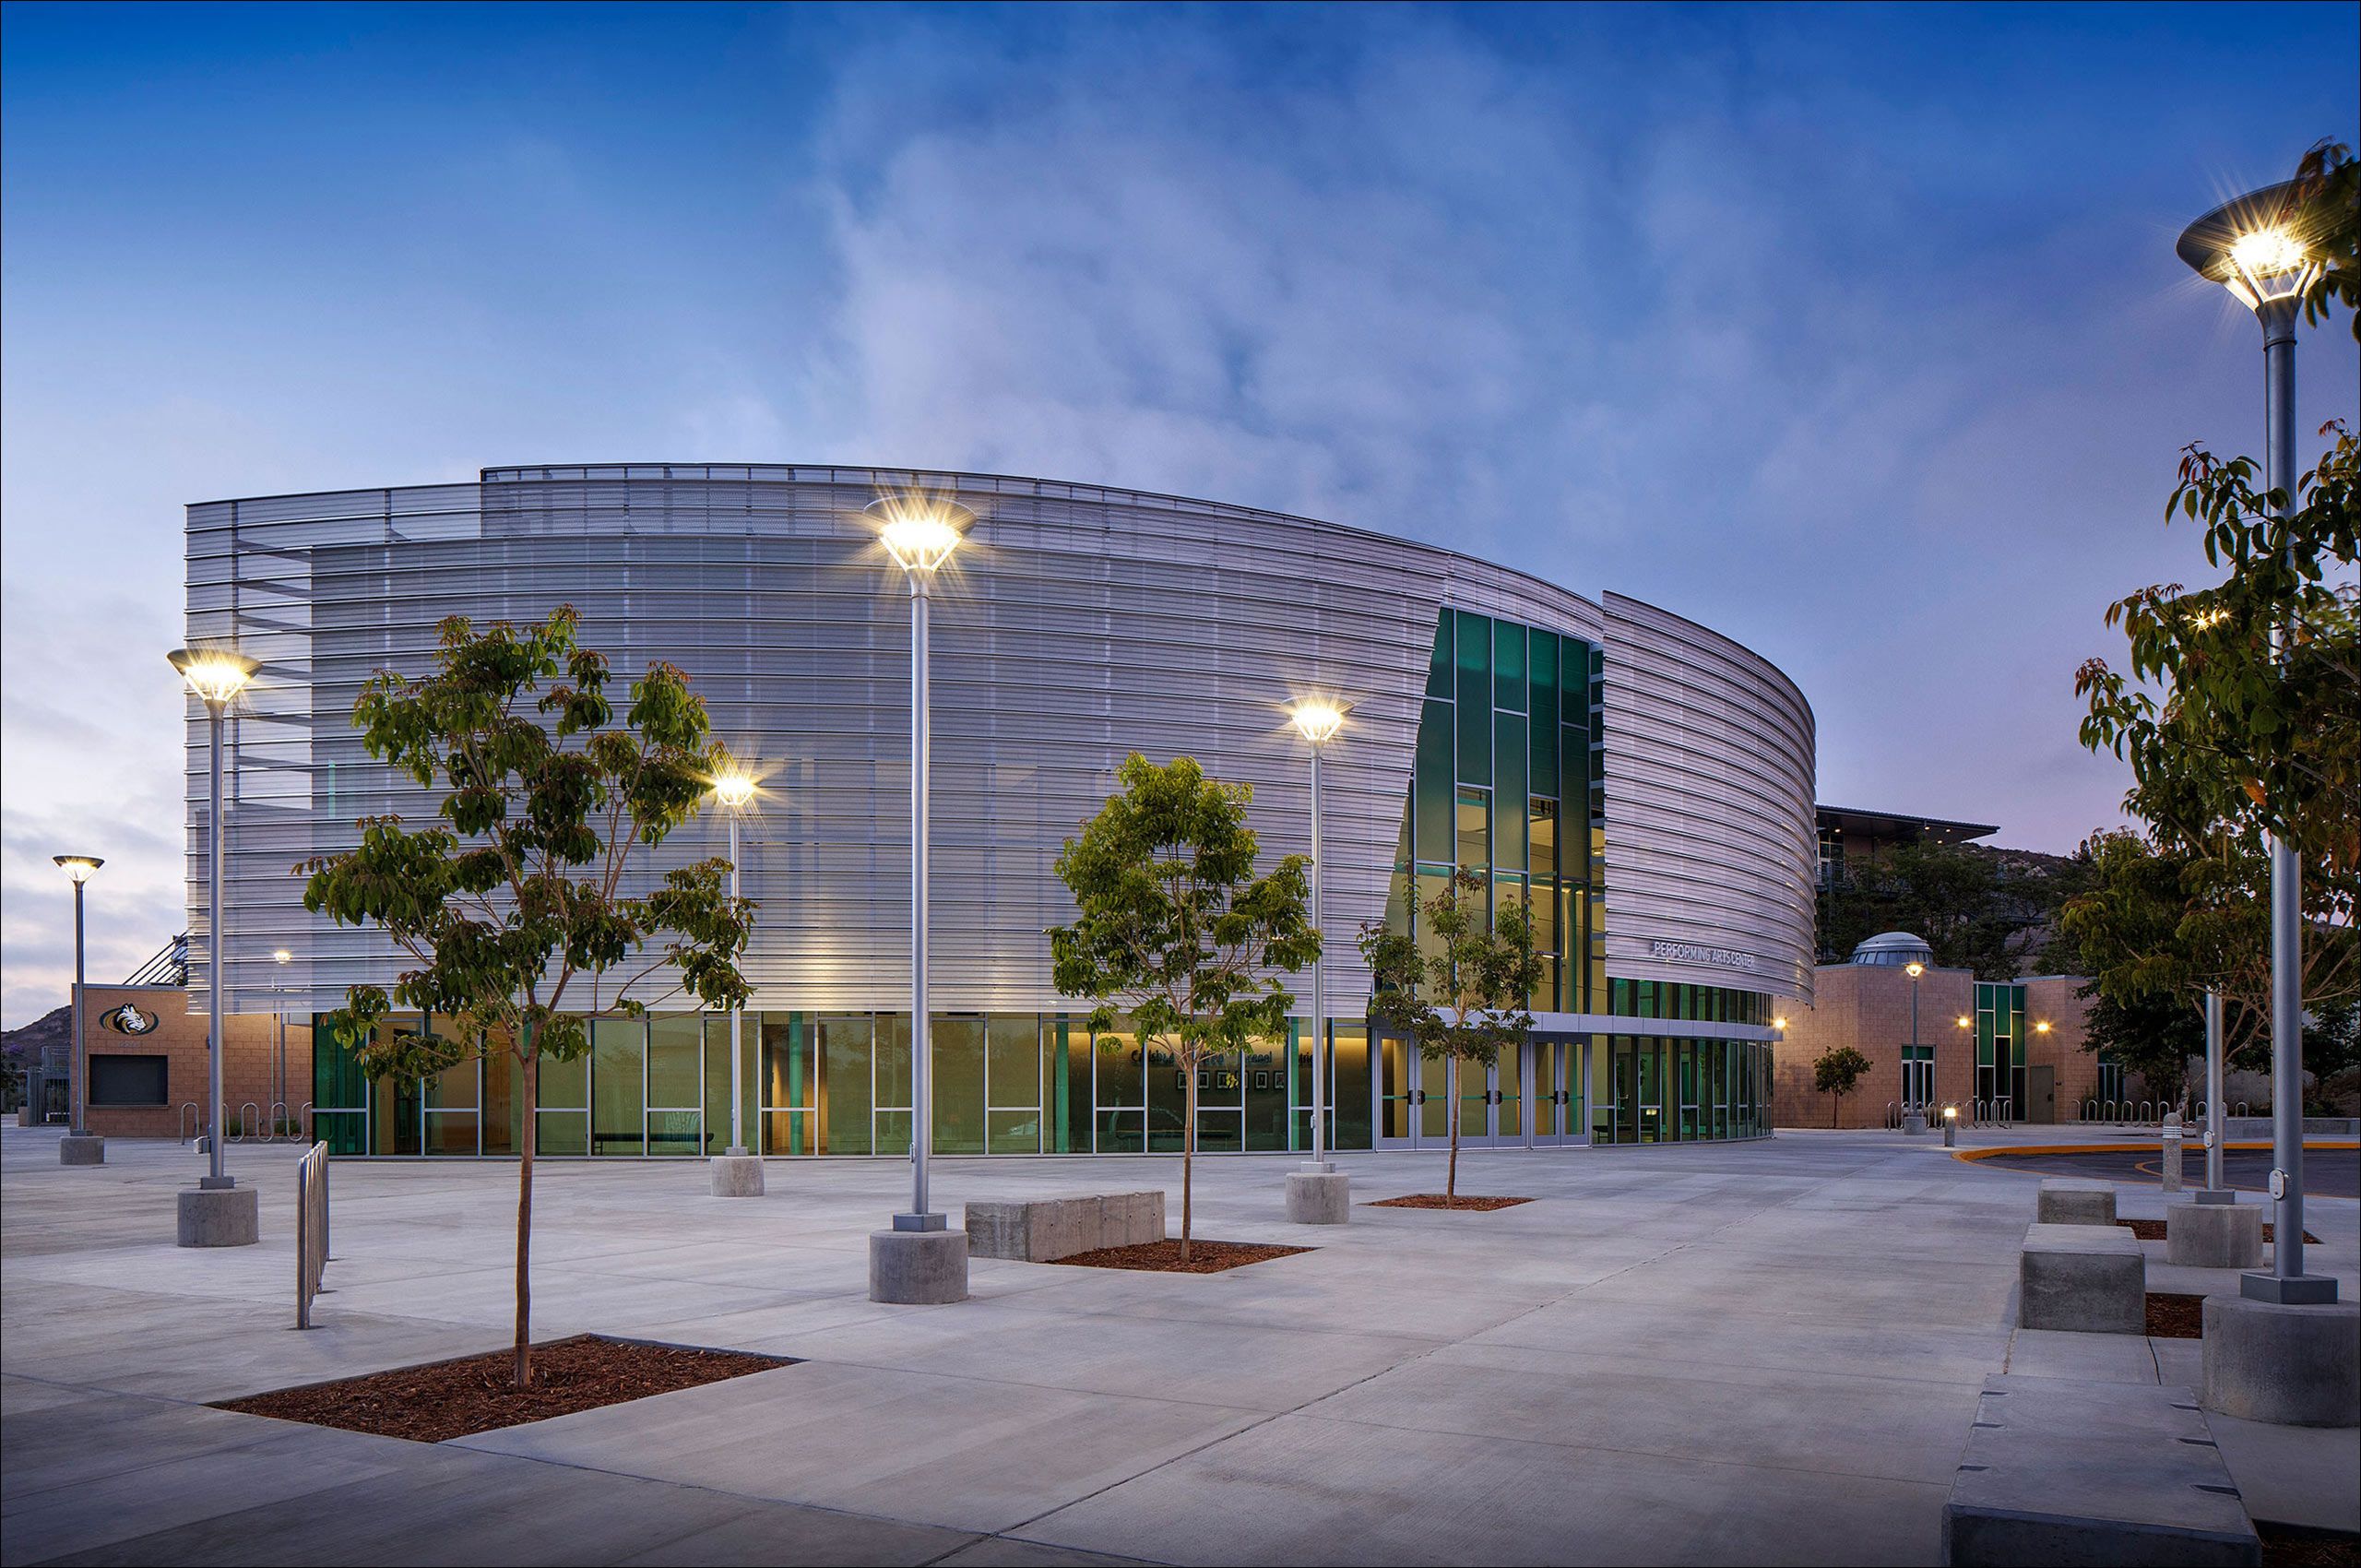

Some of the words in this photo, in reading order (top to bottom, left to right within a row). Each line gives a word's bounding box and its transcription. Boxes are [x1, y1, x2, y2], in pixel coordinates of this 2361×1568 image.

[1654, 941, 1711, 962] PERFORMING
[1712, 948, 1731, 964] ARTS
[1731, 951, 1755, 968] CENTER
